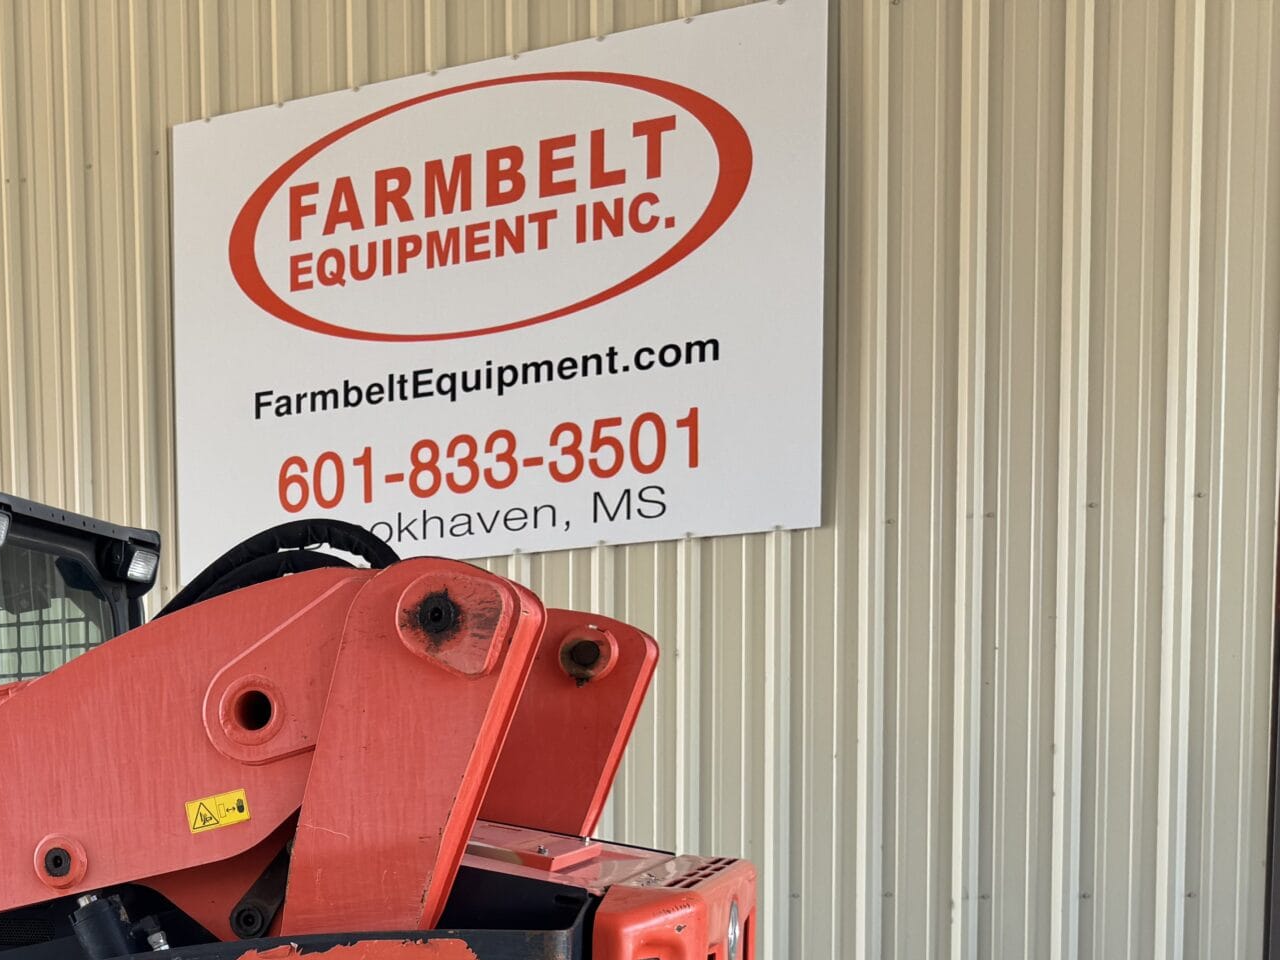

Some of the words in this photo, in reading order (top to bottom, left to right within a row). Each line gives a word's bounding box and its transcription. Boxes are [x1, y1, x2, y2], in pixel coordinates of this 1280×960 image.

[289, 115, 677, 241] FARMBELT
[289, 209, 558, 292] EQUIPMENT
[576, 192, 676, 244] INC.
[254, 337, 721, 420] FarmbeltEquipment.com
[278, 407, 701, 514] 601-833-3501
[300, 507, 572, 552] okhaven,
[592, 485, 668, 525] MS
